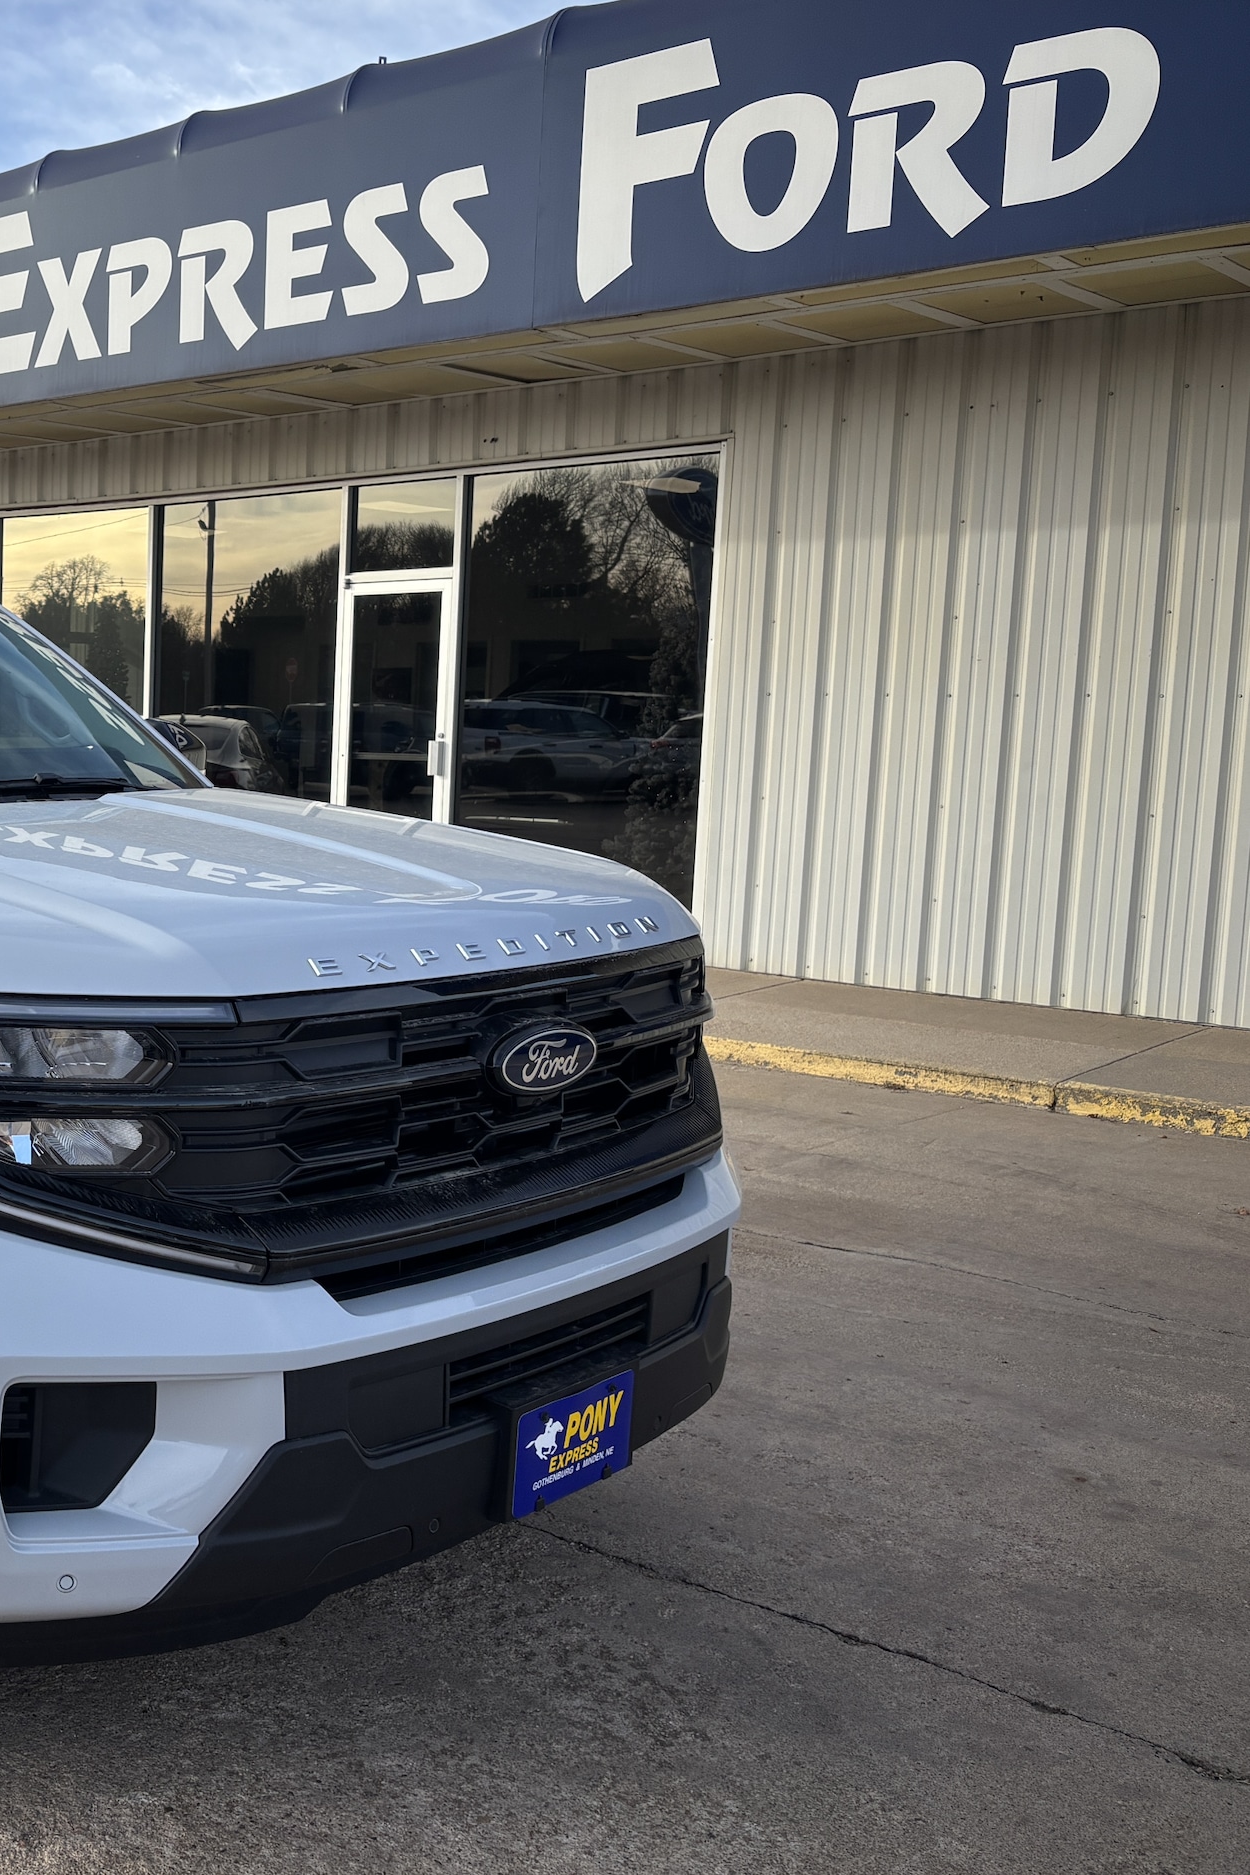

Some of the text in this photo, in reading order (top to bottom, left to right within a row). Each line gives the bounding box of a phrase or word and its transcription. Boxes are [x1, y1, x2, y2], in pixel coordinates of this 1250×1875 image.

[576, 27, 1161, 303] FORD
[307, 916, 660, 977] EXPEDITION
[522, 1038, 581, 1083] Ford
[563, 1390, 625, 1449] PONY
[532, 1465, 574, 1491] GOTHENBURG
[548, 1437, 599, 1472] EXPRESS
